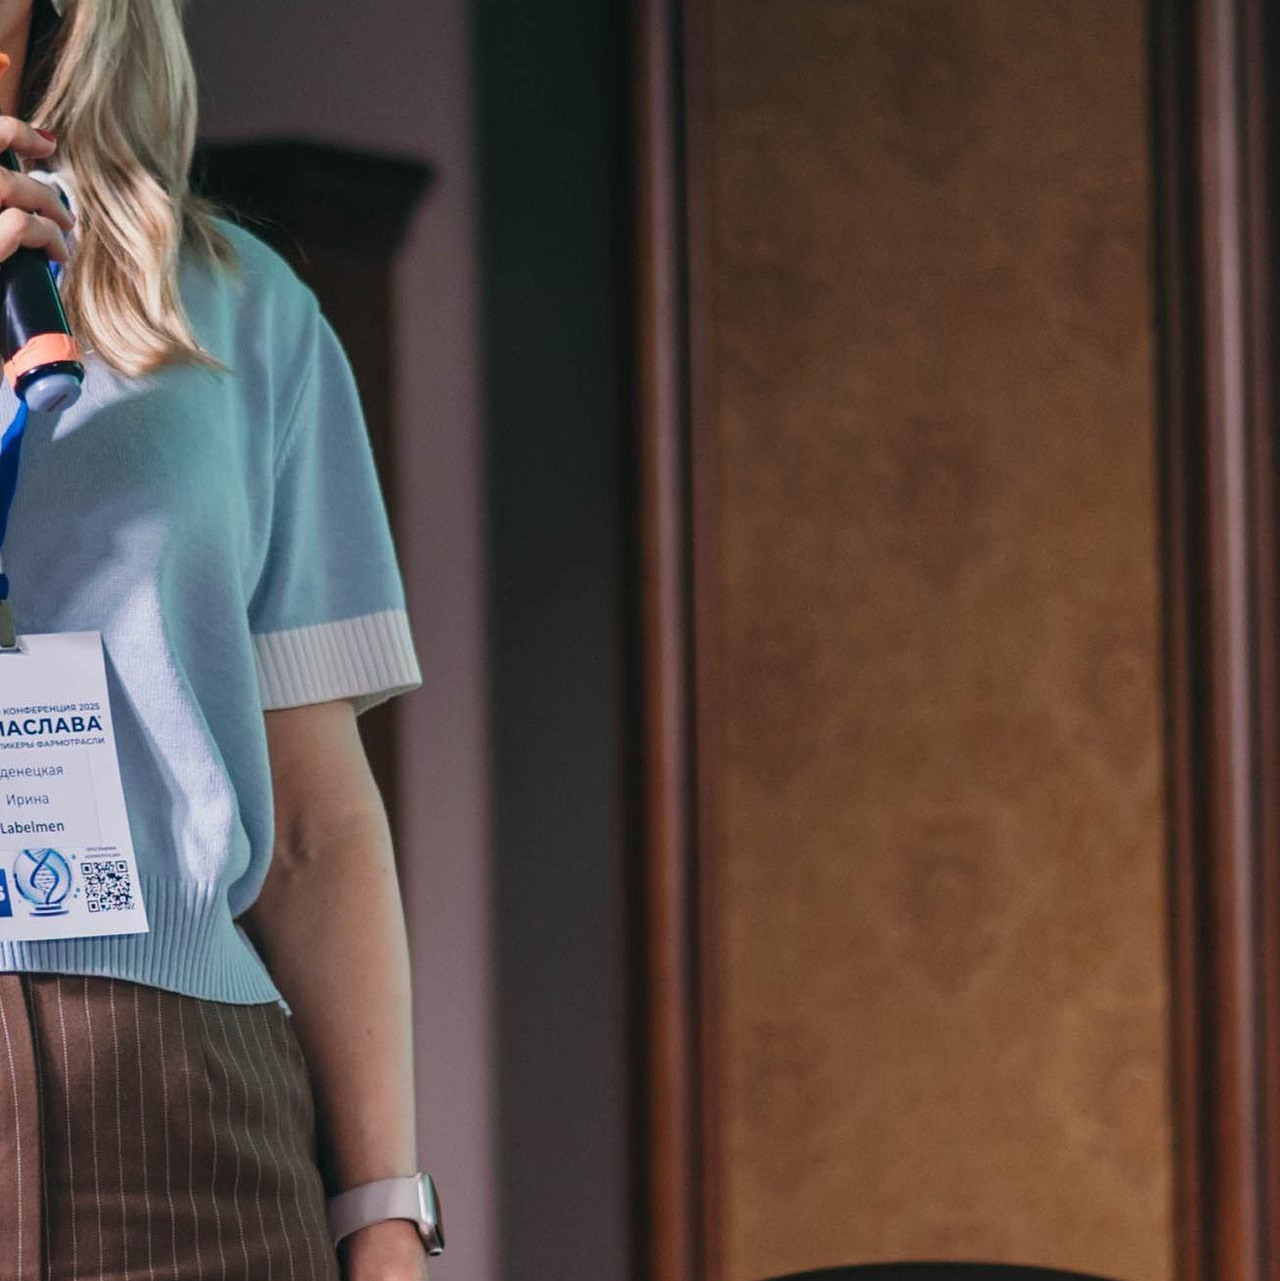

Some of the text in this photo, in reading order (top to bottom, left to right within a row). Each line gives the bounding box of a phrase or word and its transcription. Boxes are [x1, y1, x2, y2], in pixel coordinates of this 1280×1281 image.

[3, 704, 77, 716] КОНФЕРЕНЦИЯ
[79, 702, 101, 712] 2025
[36, 737, 105, 748] ФАРМОТРАСЛИ
[6, 794, 49, 807] Ирина
[0, 820, 65, 834] Labelmen
